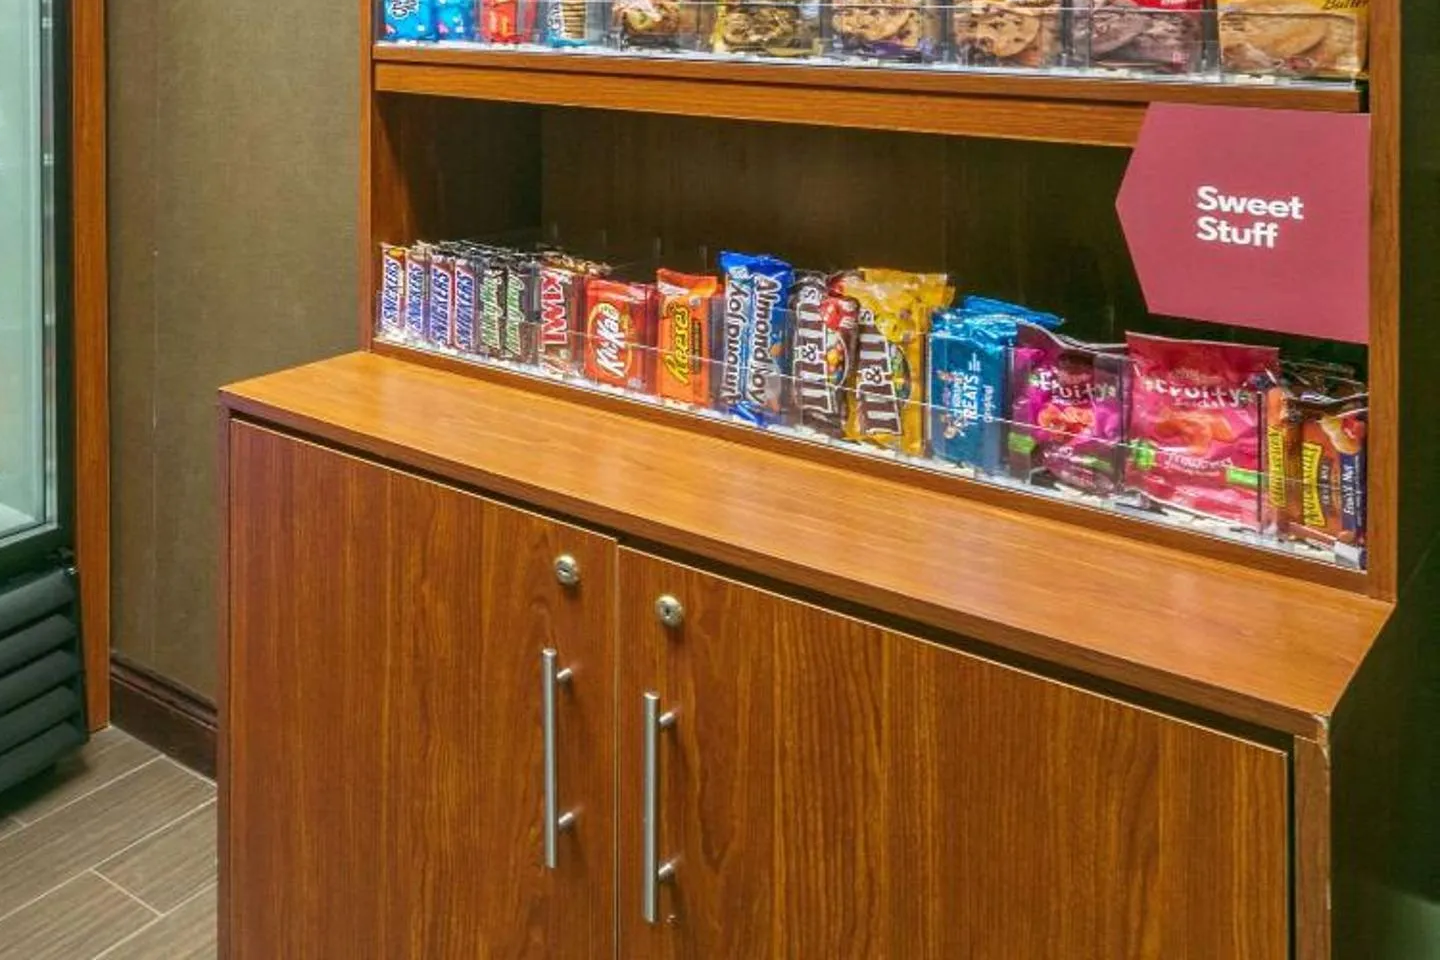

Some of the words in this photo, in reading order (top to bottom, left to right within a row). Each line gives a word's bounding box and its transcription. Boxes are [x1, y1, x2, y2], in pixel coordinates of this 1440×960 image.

[1195, 185, 1305, 220] Sweet
[1195, 216, 1280, 249] Stuff
[383, 258, 400, 324] SNICKERS
[408, 262, 424, 331] SNICKERS
[430, 269, 450, 344] SNICKERS
[455, 272, 474, 346] SNICKERS
